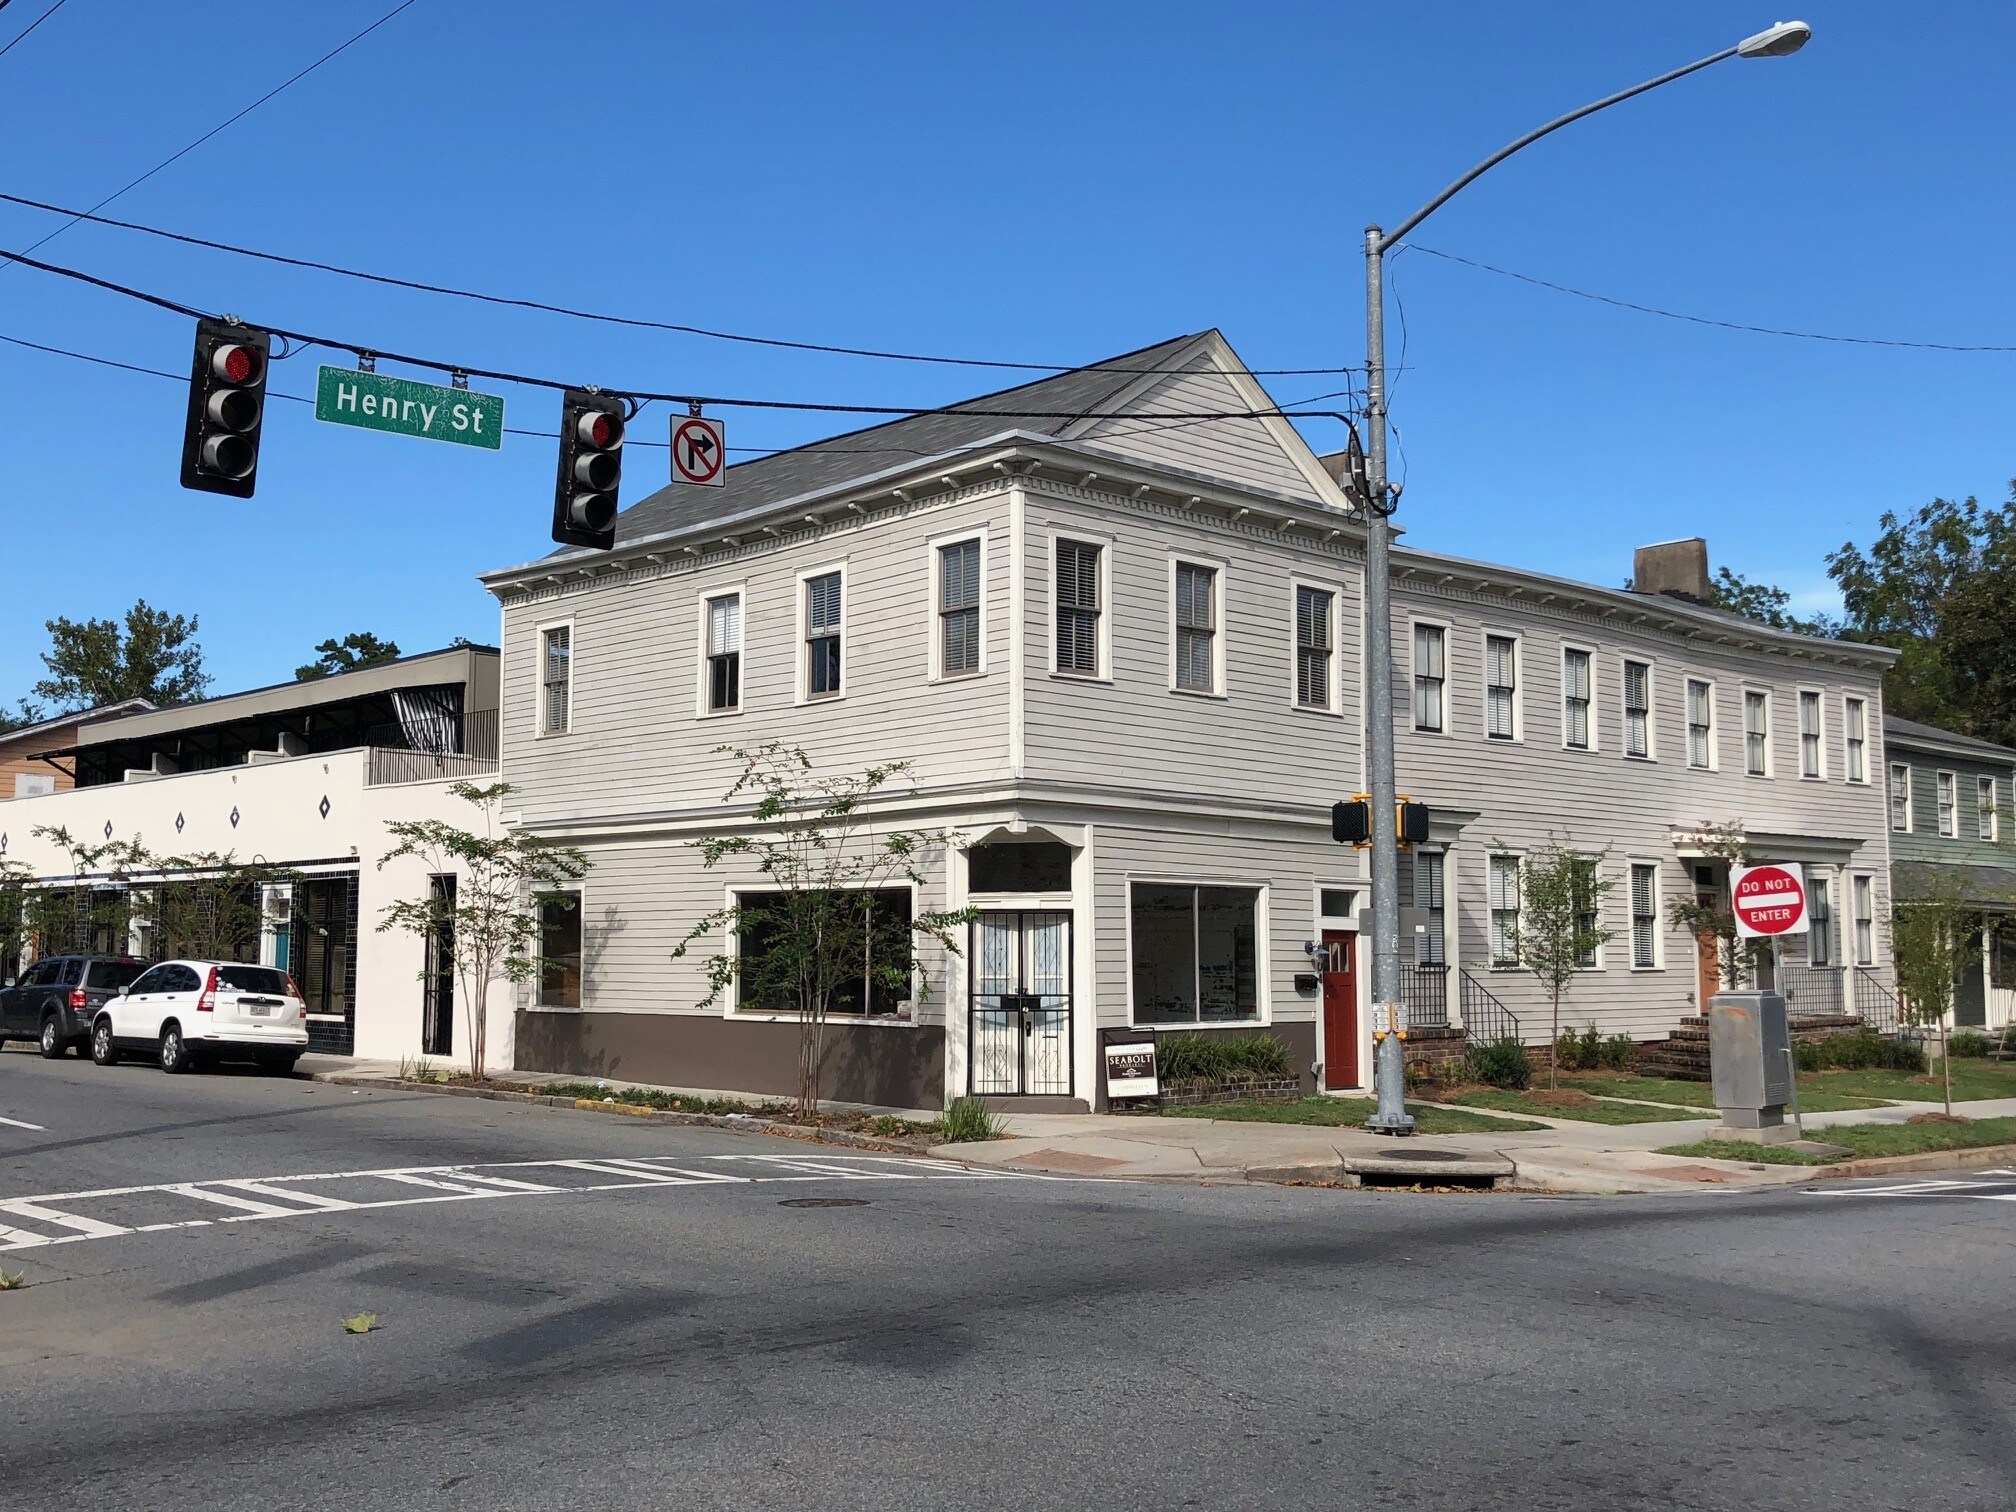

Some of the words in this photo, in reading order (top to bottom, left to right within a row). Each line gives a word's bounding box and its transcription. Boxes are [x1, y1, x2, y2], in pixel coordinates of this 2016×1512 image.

[336, 382, 438, 431] Henry
[452, 403, 485, 434] St
[1741, 881, 1759, 893] DO
[1765, 878, 1791, 890] NOT
[1750, 909, 1791, 922] ENTER
[1109, 1055, 1151, 1065] SEABOLT
